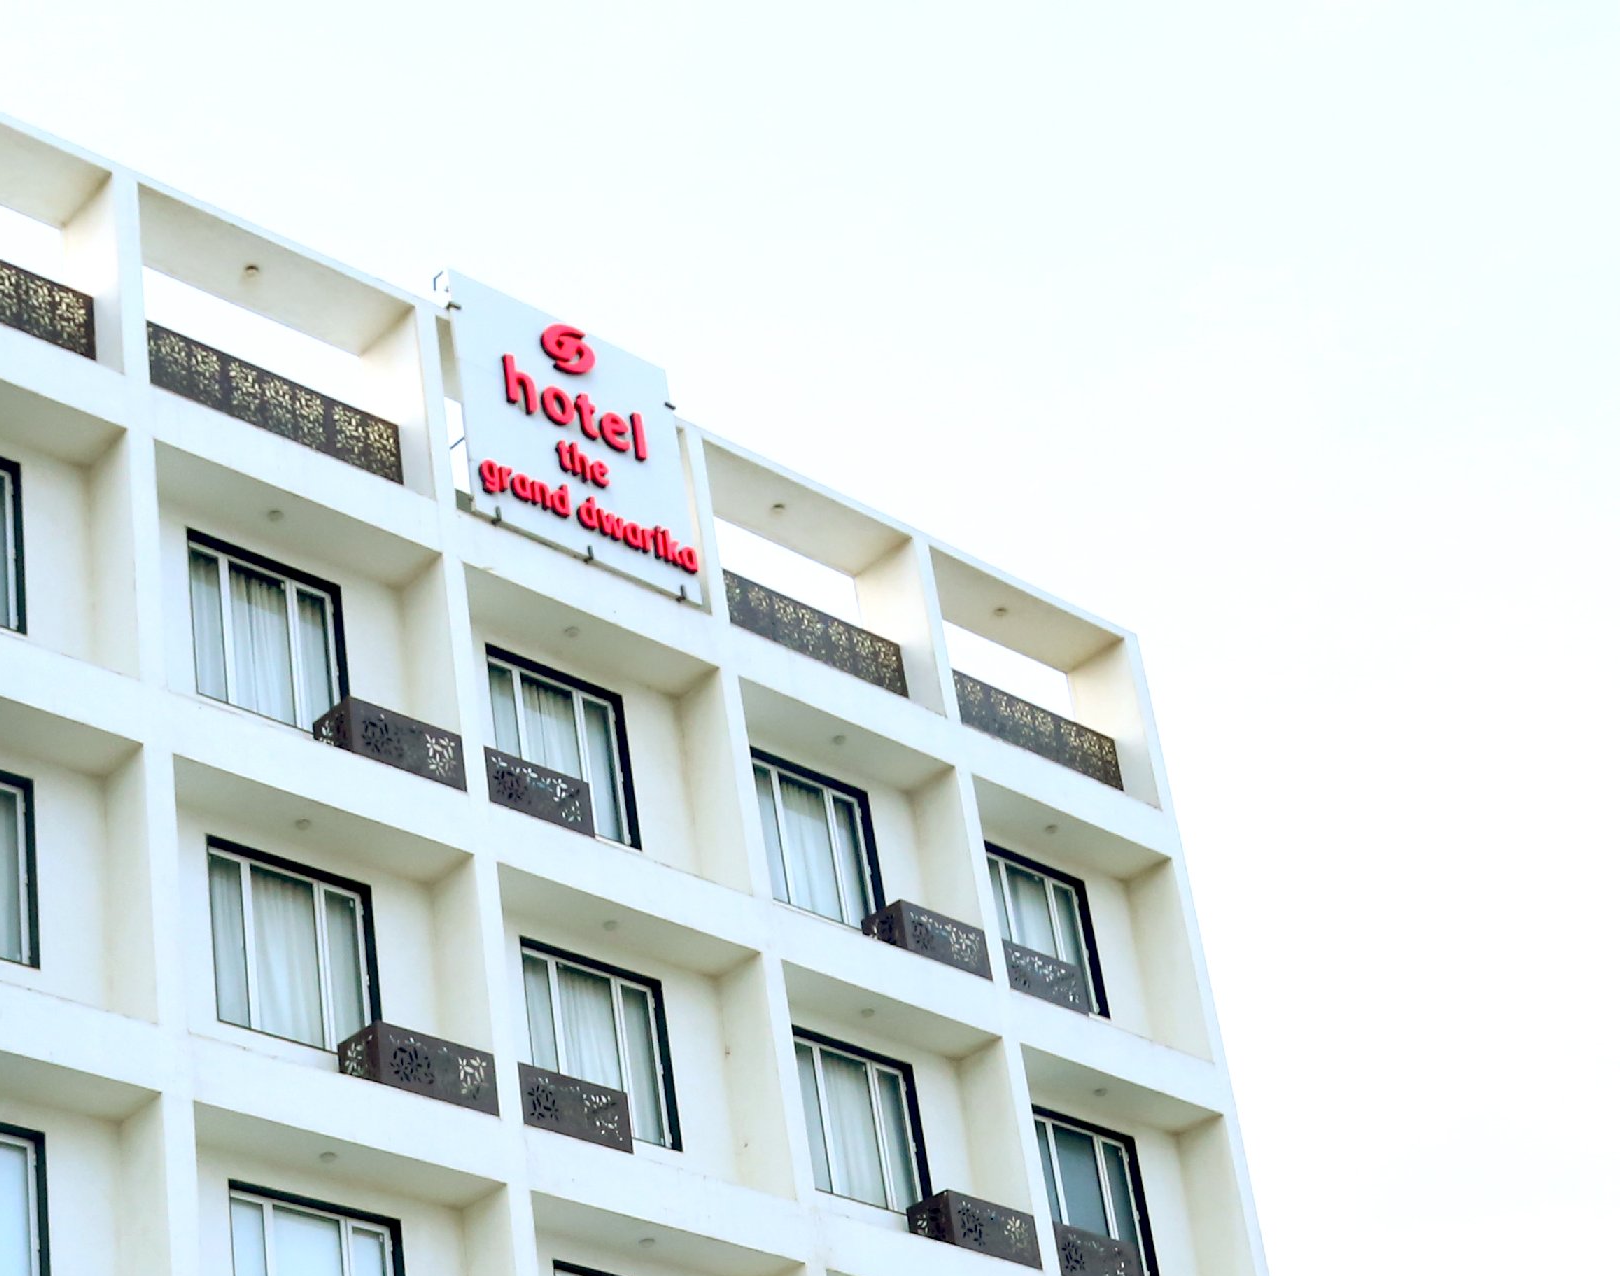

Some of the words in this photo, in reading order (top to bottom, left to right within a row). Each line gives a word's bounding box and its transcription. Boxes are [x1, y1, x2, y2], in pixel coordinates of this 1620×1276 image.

[502, 353, 648, 462] hotel
[479, 459, 572, 517] grand
[577, 496, 698, 574] dwarika
[555, 439, 610, 488] the
